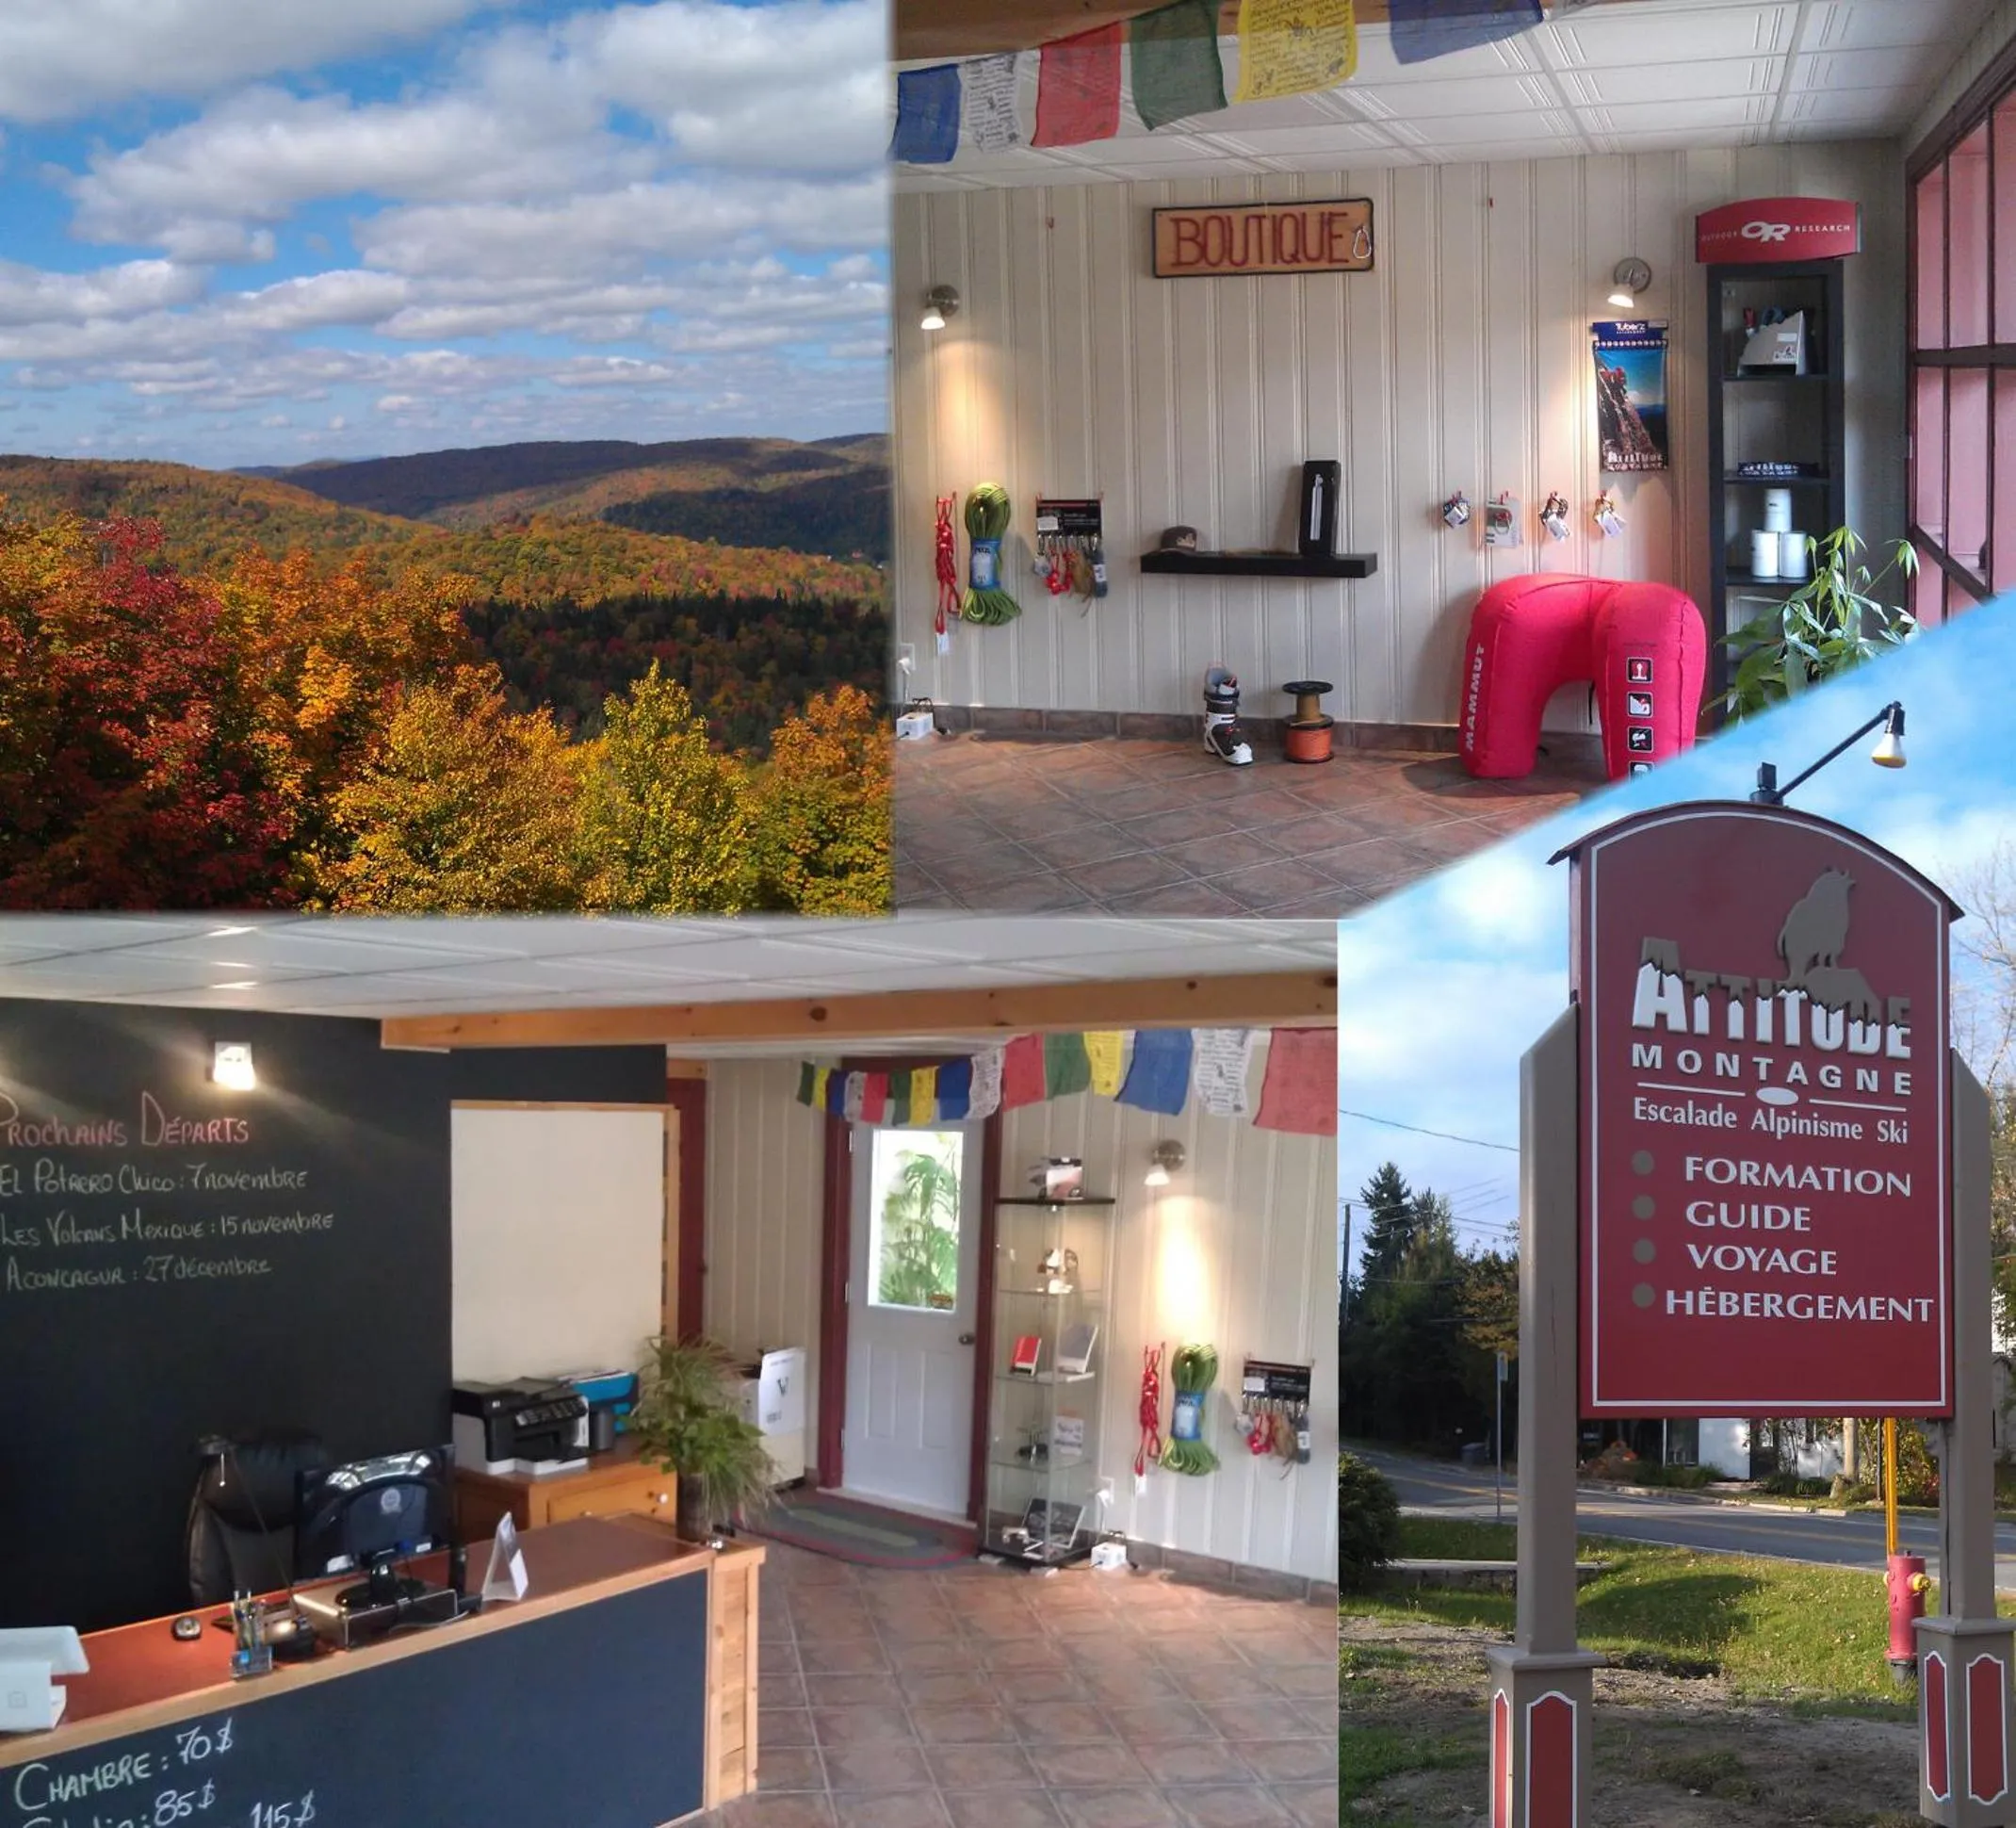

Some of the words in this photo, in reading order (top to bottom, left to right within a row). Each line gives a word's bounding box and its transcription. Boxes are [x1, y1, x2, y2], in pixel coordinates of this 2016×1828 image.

[1169, 211, 1349, 268] BOUTIQUE
[1795, 224, 1851, 233] RESEARCH
[1465, 644, 1485, 752] MAMMUT
[1633, 937, 1911, 1059] ATTITUDE
[1632, 1043, 1911, 1095] MONTAGNE
[1634, 1096, 1737, 1128] Escalade
[1751, 1107, 1862, 1139] Alpinisme
[1877, 1119, 1908, 1144] Ski
[1685, 1156, 1911, 1197] FORMATION
[220, 1214, 238, 1235] 15
[1685, 1200, 1811, 1232] GUIDE
[143, 1254, 174, 1281] 27
[1686, 1244, 1837, 1275] VOYAGE
[1666, 1286, 1934, 1322] HÉBERGEMENT
